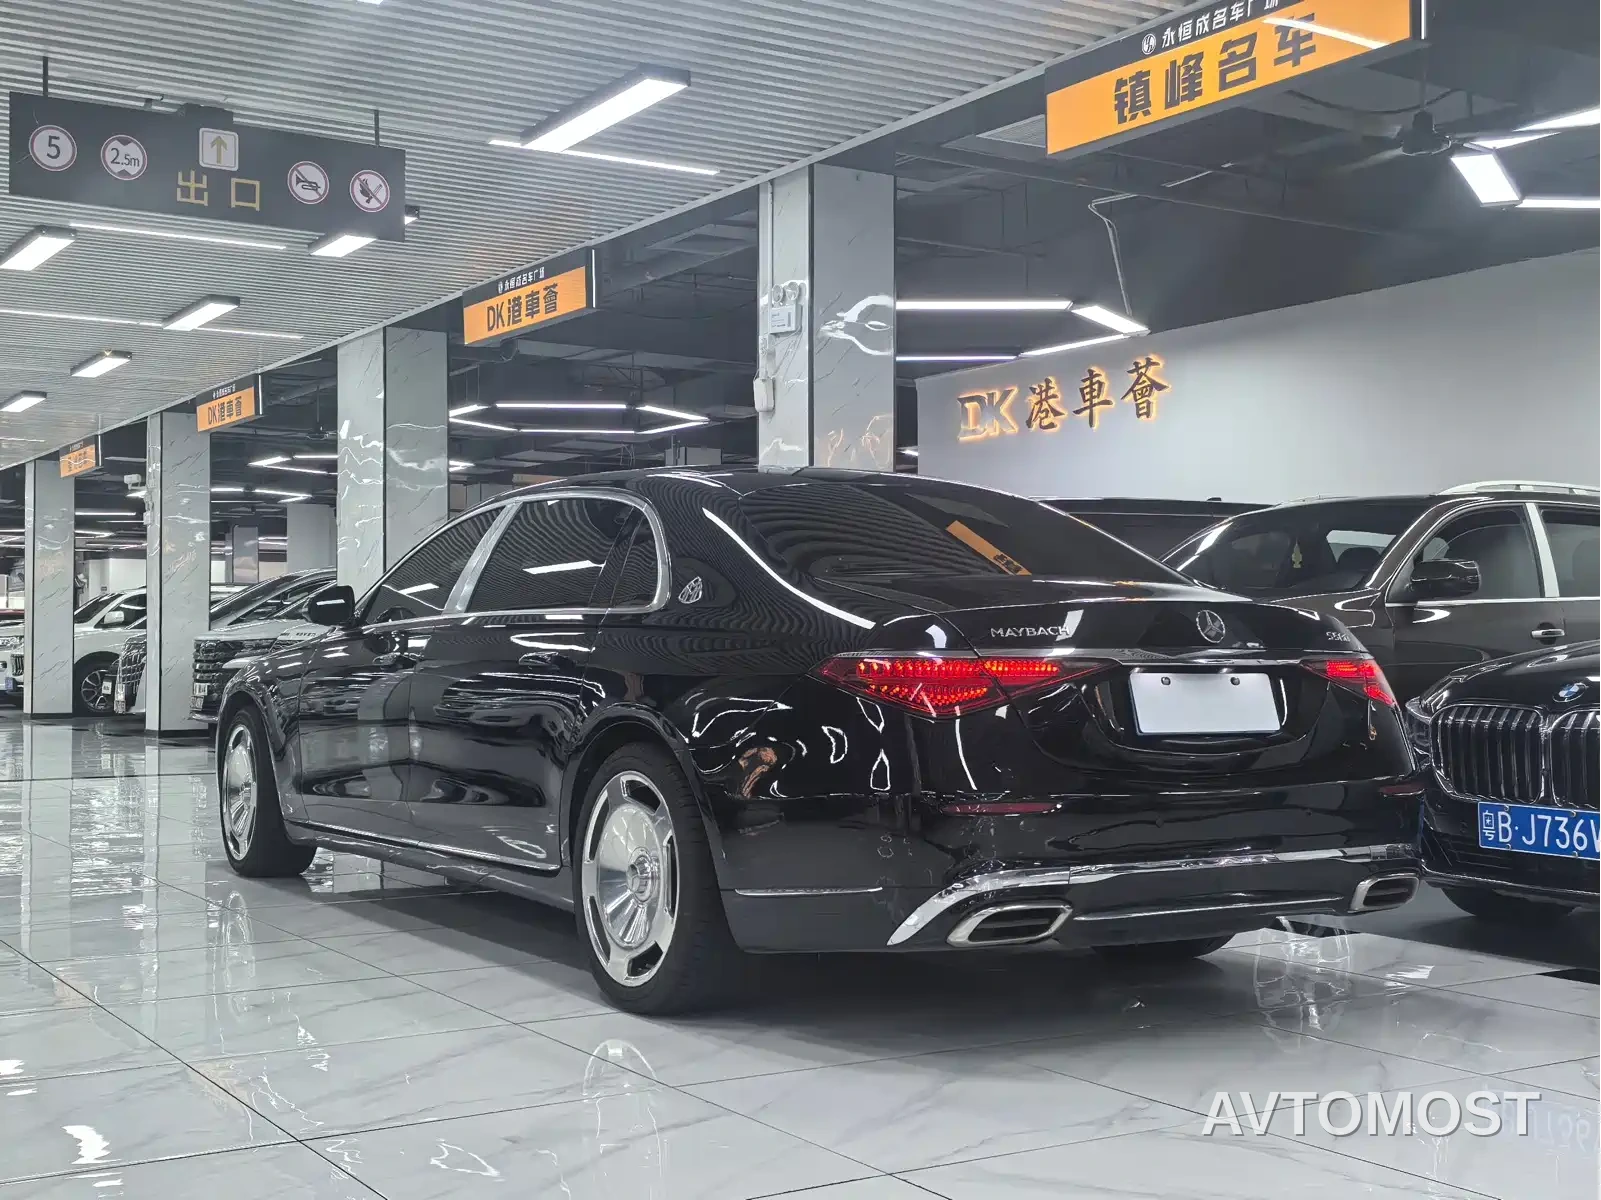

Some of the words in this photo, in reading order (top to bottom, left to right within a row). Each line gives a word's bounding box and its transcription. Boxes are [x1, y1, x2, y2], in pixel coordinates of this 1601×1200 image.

[1113, 12, 1317, 126] 镇峰名车
[46, 135, 61, 160] 5
[110, 147, 141, 168] 2.5m
[176, 169, 261, 212] 出口
[990, 625, 1070, 638] MAYBACH
